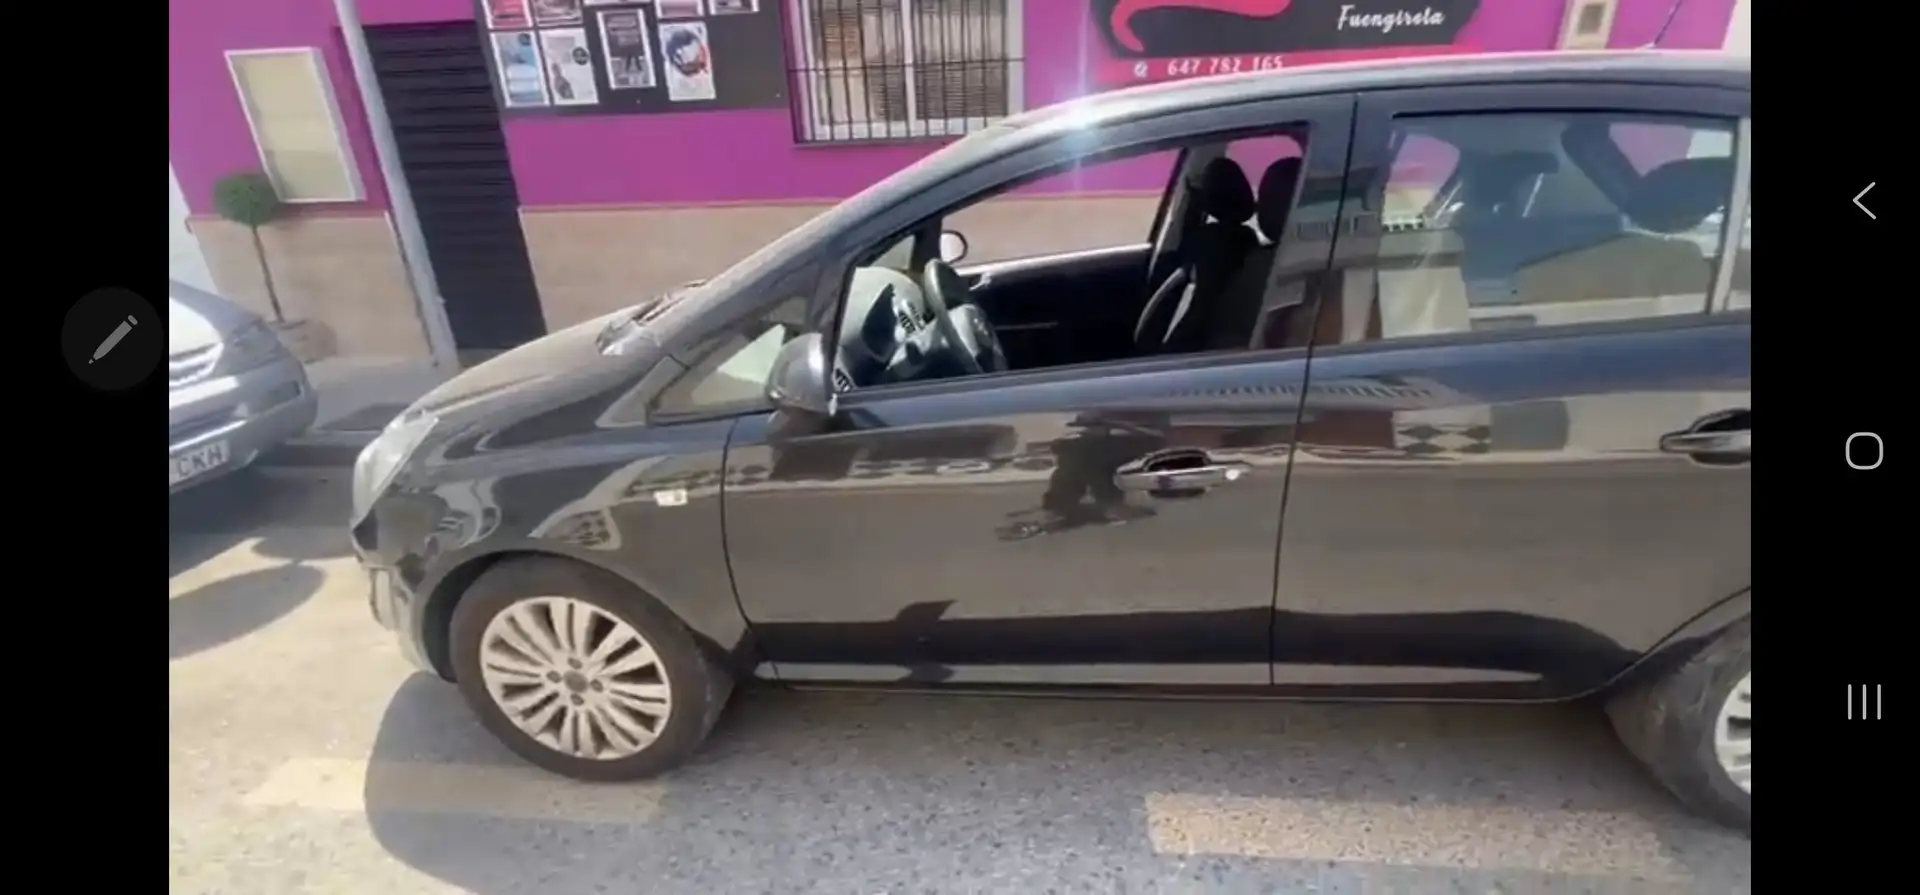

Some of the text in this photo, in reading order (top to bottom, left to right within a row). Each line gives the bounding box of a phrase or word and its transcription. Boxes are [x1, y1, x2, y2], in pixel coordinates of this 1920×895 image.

[1337, 4, 1446, 33] Fuengirola
[1167, 55, 1283, 76] 647 782 165
